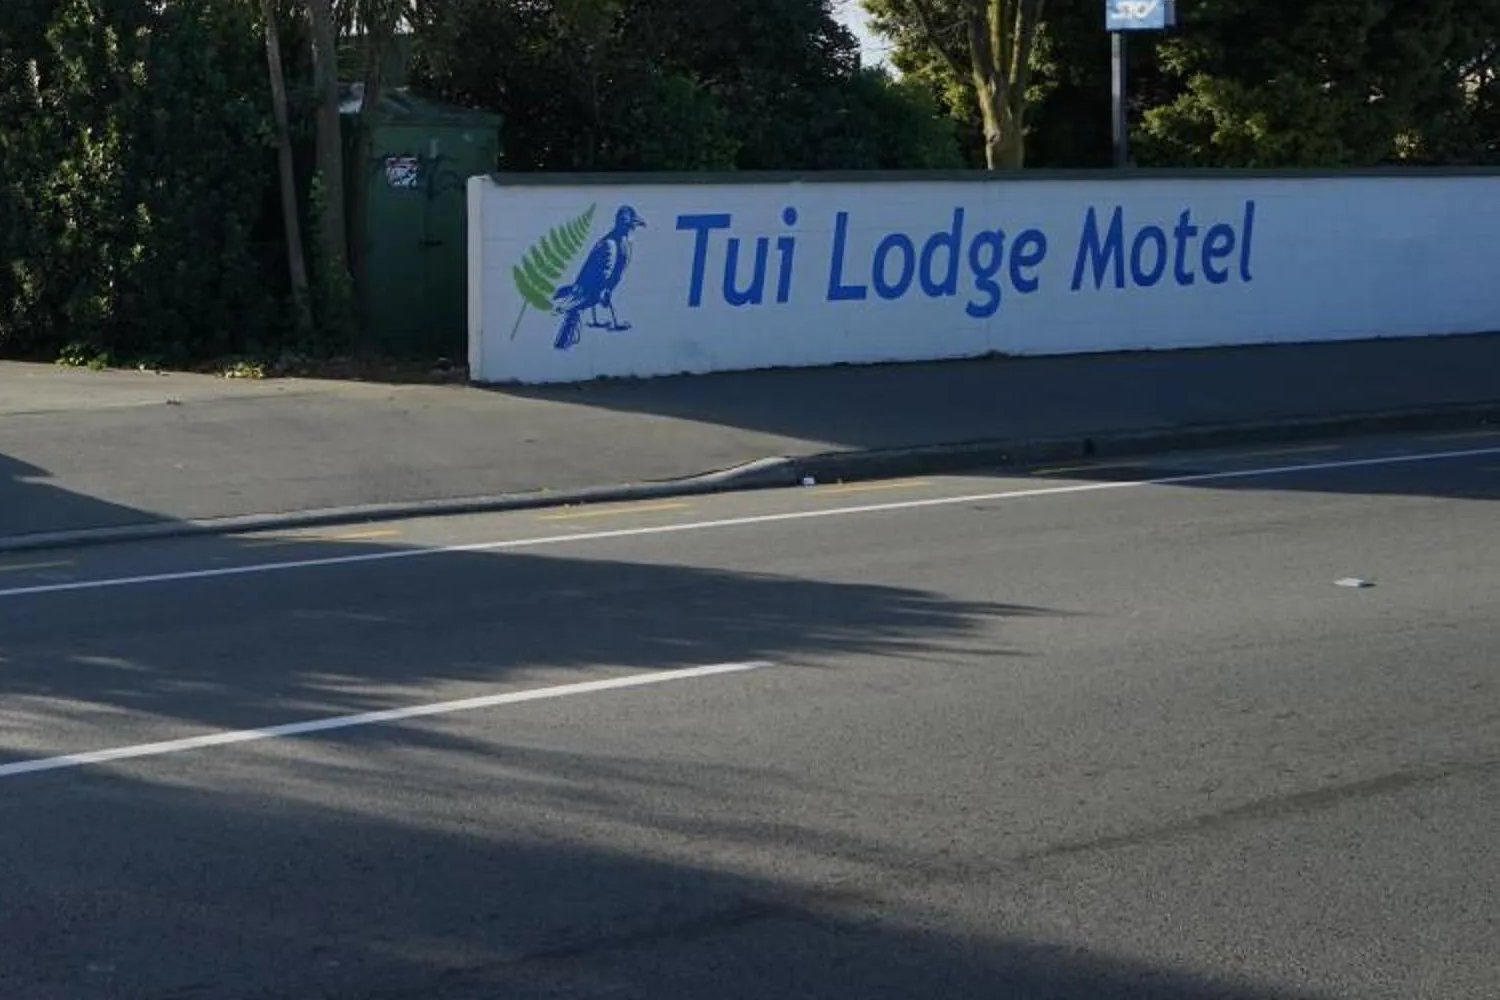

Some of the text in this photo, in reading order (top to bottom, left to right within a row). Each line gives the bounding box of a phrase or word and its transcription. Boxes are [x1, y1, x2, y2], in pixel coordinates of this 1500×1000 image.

[675, 201, 1255, 318] Tui Lodge Motel
